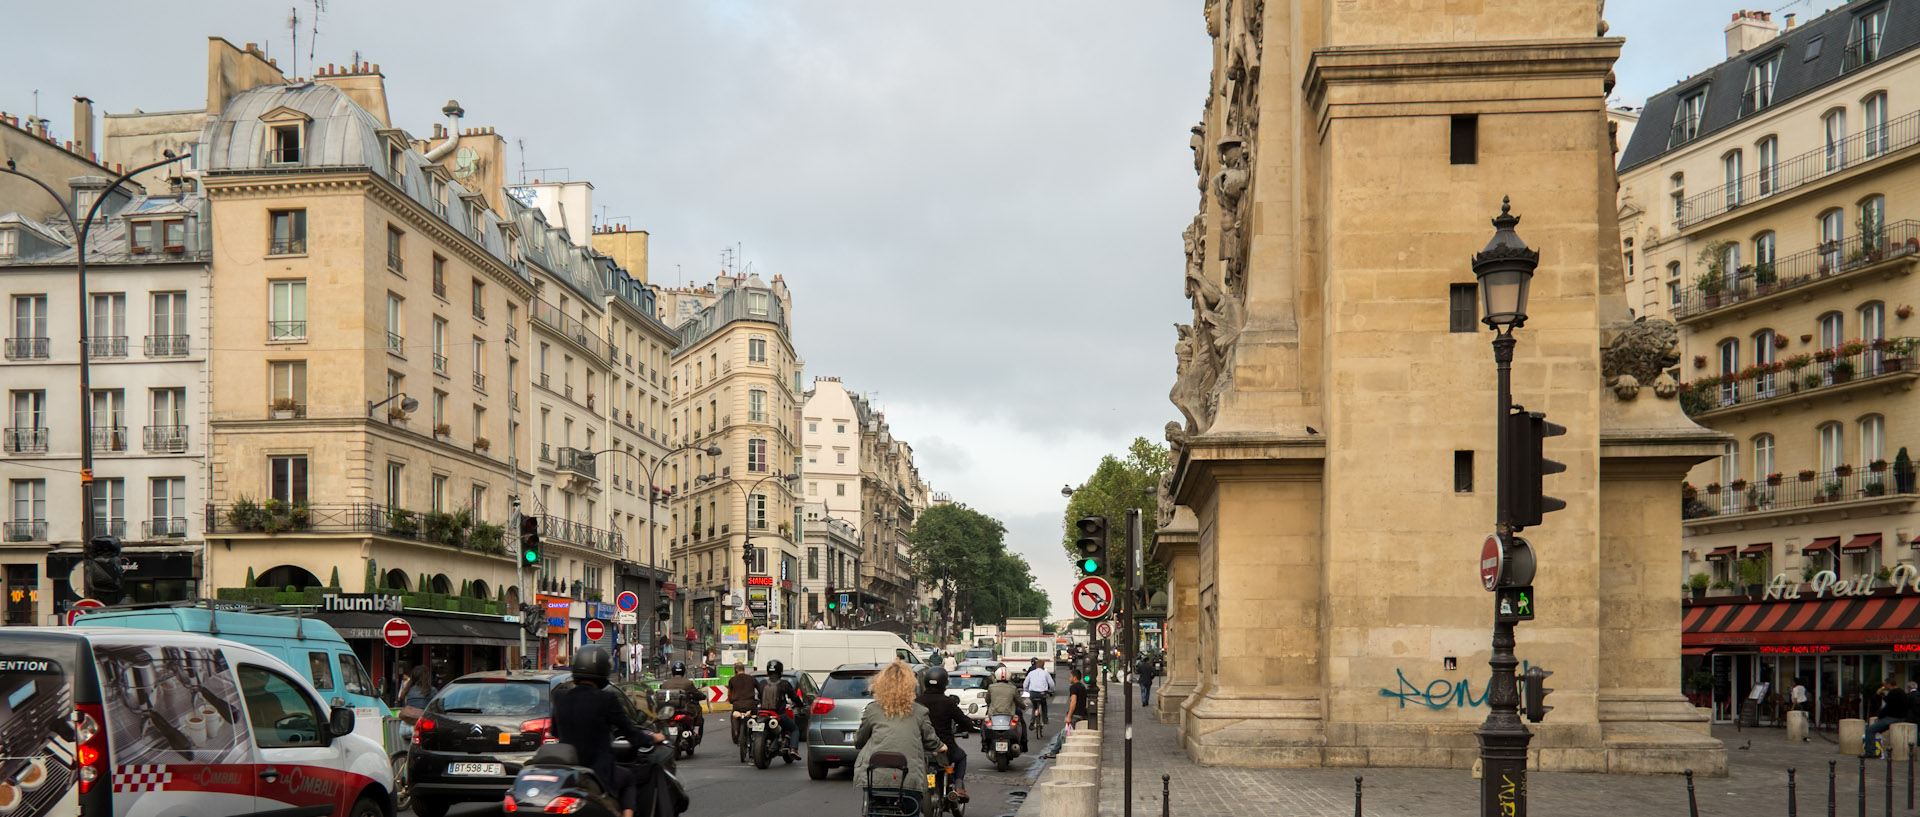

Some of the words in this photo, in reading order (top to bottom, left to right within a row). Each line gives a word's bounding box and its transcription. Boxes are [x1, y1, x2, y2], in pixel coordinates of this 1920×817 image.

[1762, 572, 1801, 601] Au
[1811, 569, 1875, 598] Petit
[1760, 646, 1791, 654] SERVICE
[1792, 646, 1808, 654] NON
[1809, 645, 1830, 653] STOP
